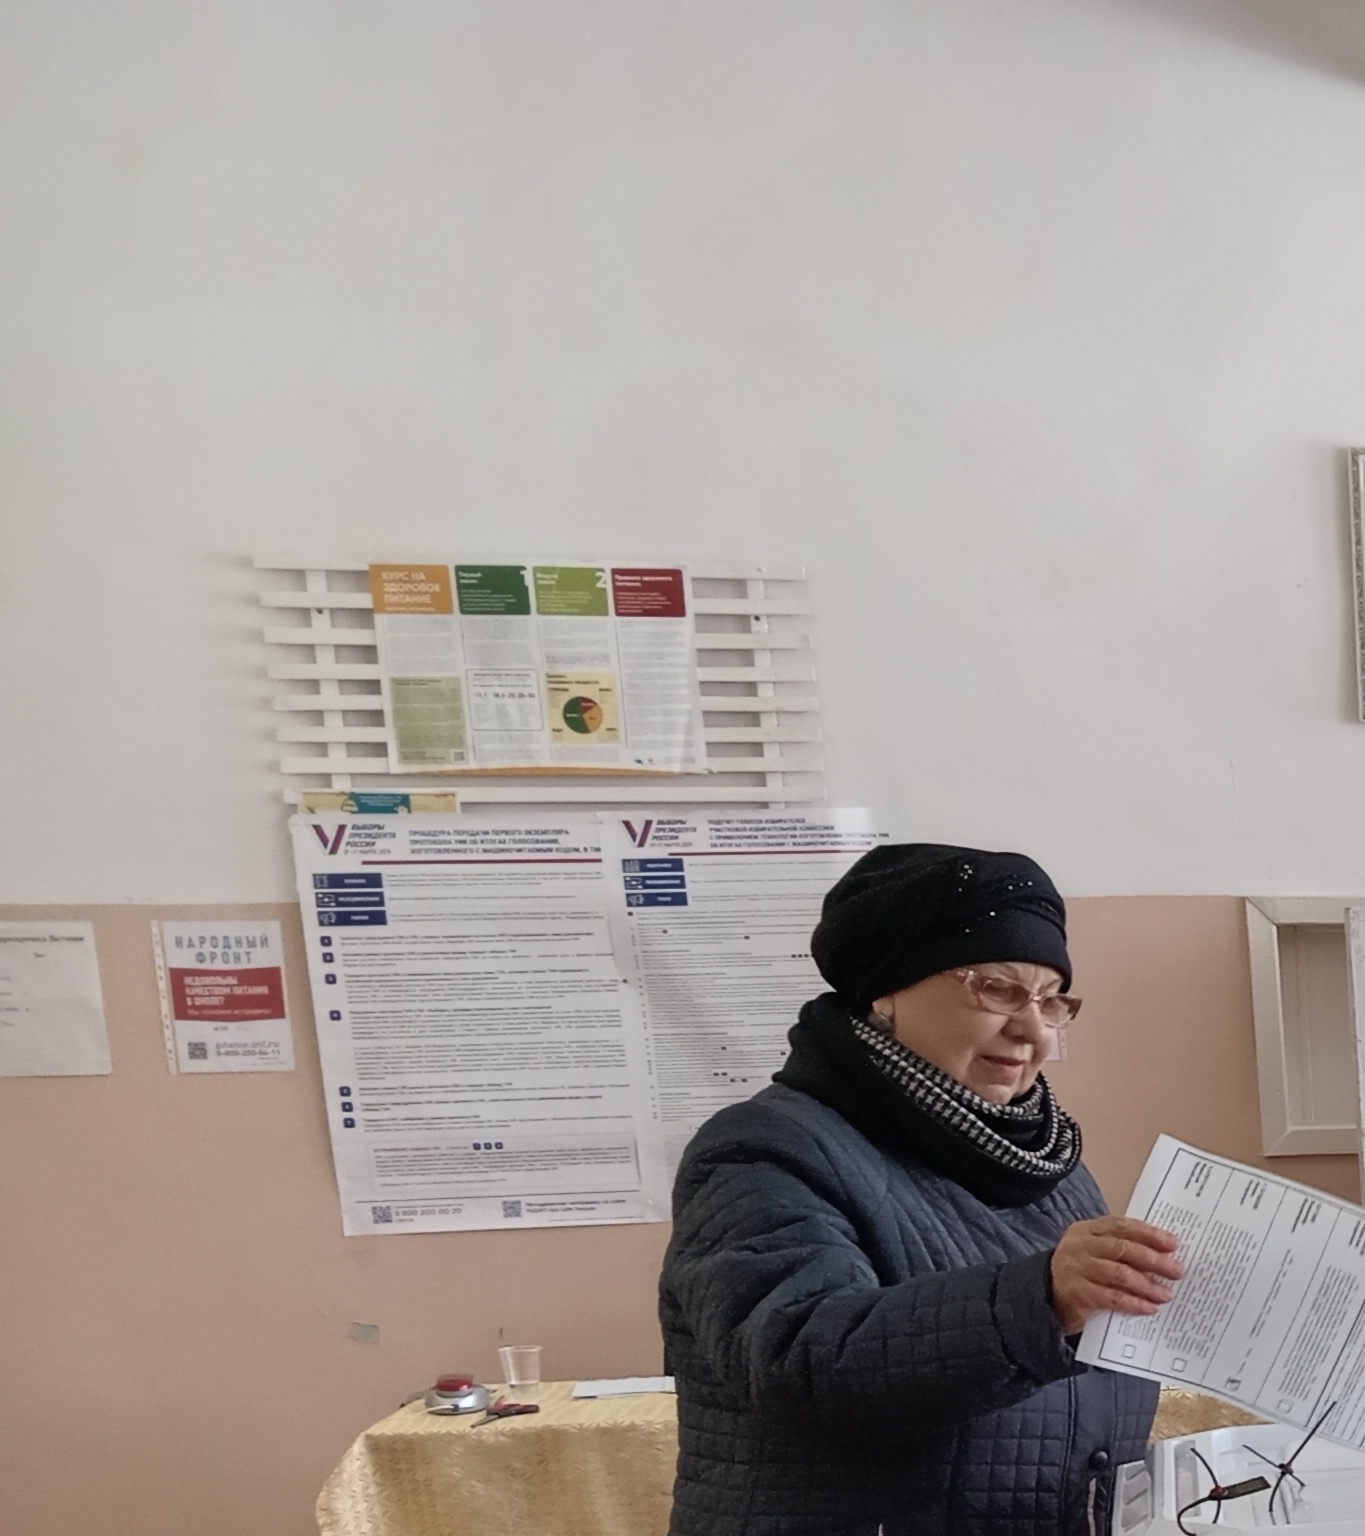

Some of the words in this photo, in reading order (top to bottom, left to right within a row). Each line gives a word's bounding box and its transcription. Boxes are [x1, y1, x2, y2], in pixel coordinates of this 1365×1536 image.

[383, 582, 441, 592] ЗДОРОВОЕ
[384, 594, 431, 603] ПИТАНИЕ
[345, 840, 376, 848] РОССИИ
[174, 933, 269, 950] НАРОДНЫЙ
[195, 951, 252, 964] ФРОНТ
[183, 976, 238, 986] НЕДОВОЛЬНЫ
[185, 986, 231, 995] КАЧЕСТВОМ
[232, 985, 269, 995] ПИТАНИЯ
